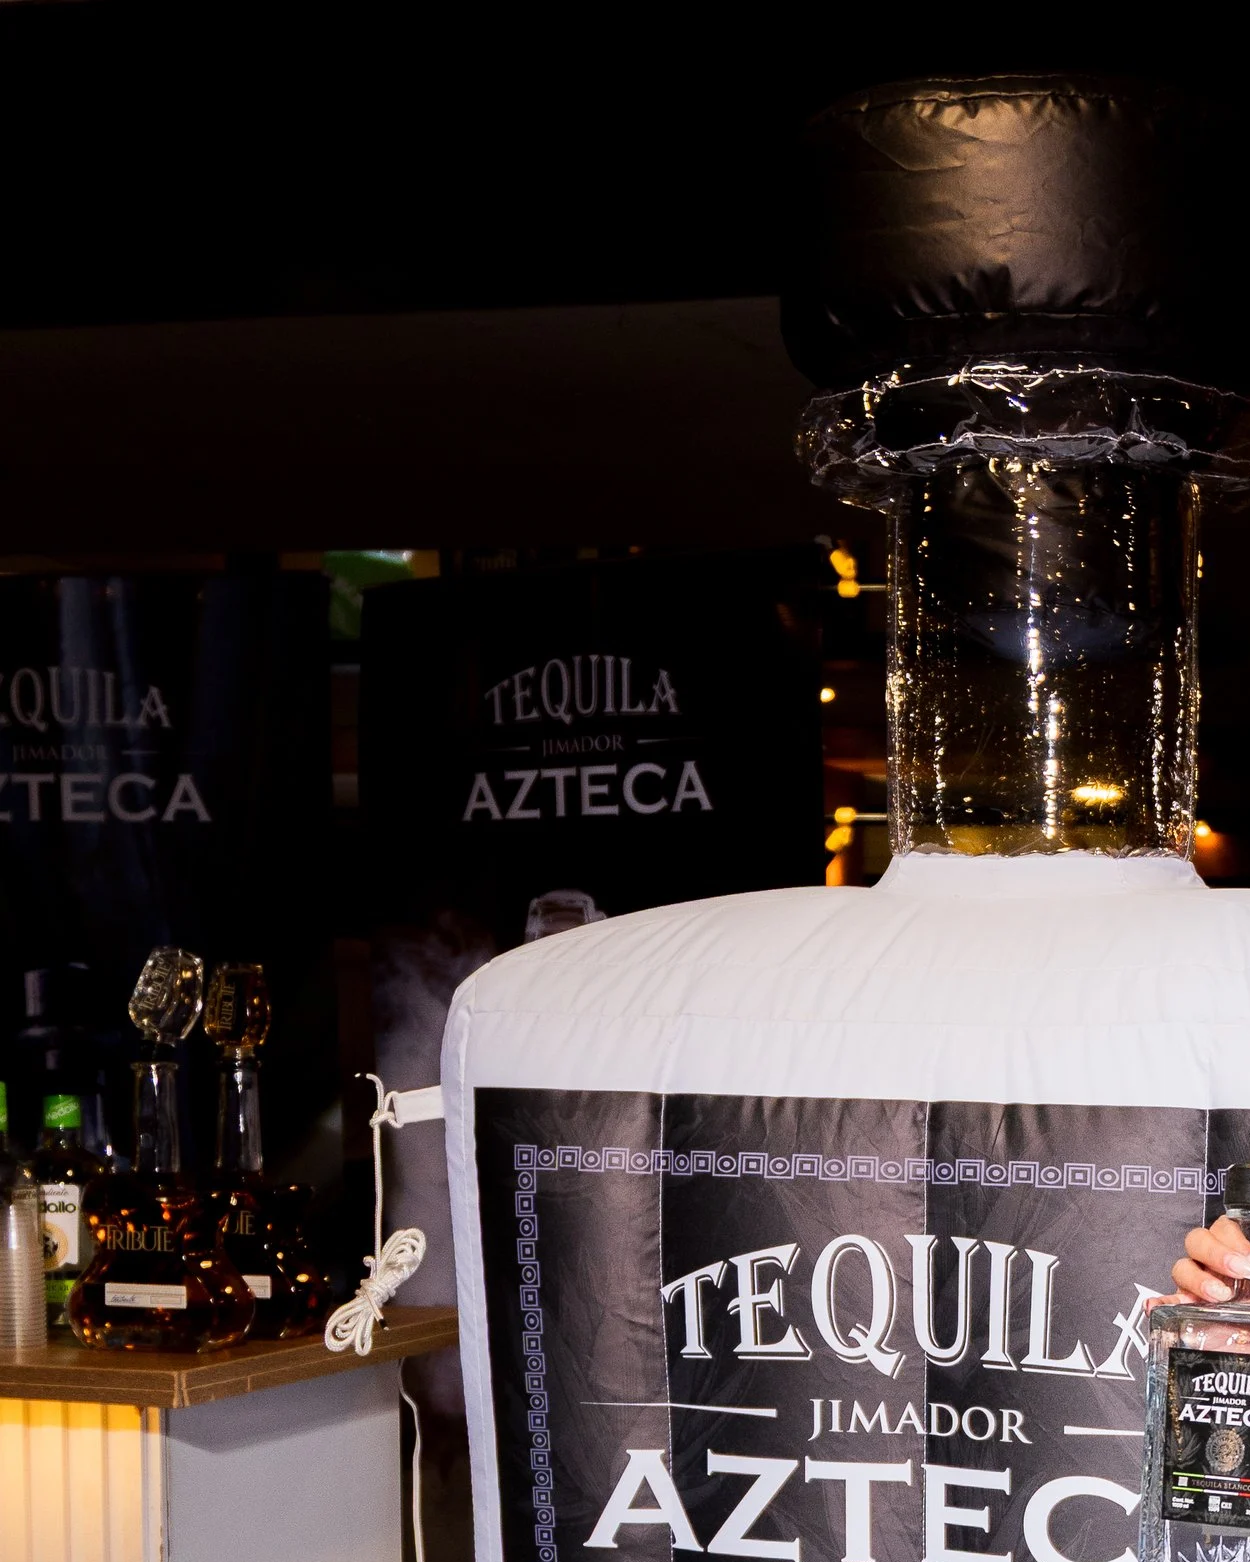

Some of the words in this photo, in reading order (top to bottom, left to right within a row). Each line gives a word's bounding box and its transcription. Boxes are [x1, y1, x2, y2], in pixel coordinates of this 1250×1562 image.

[0, 667, 172, 732] QUILA
[484, 654, 681, 725] TEQUILA
[543, 735, 624, 757] JIMADOR
[0, 773, 212, 822] TECA
[462, 760, 714, 821] AZTECA
[40, 1200, 77, 1214] dallo
[101, 1224, 175, 1251] TRIBUTE
[1212, 1397, 1247, 1406] JIMADOR
[808, 1398, 1033, 1444] JIMADOR
[1192, 1479, 1222, 1489] TEQUILA
